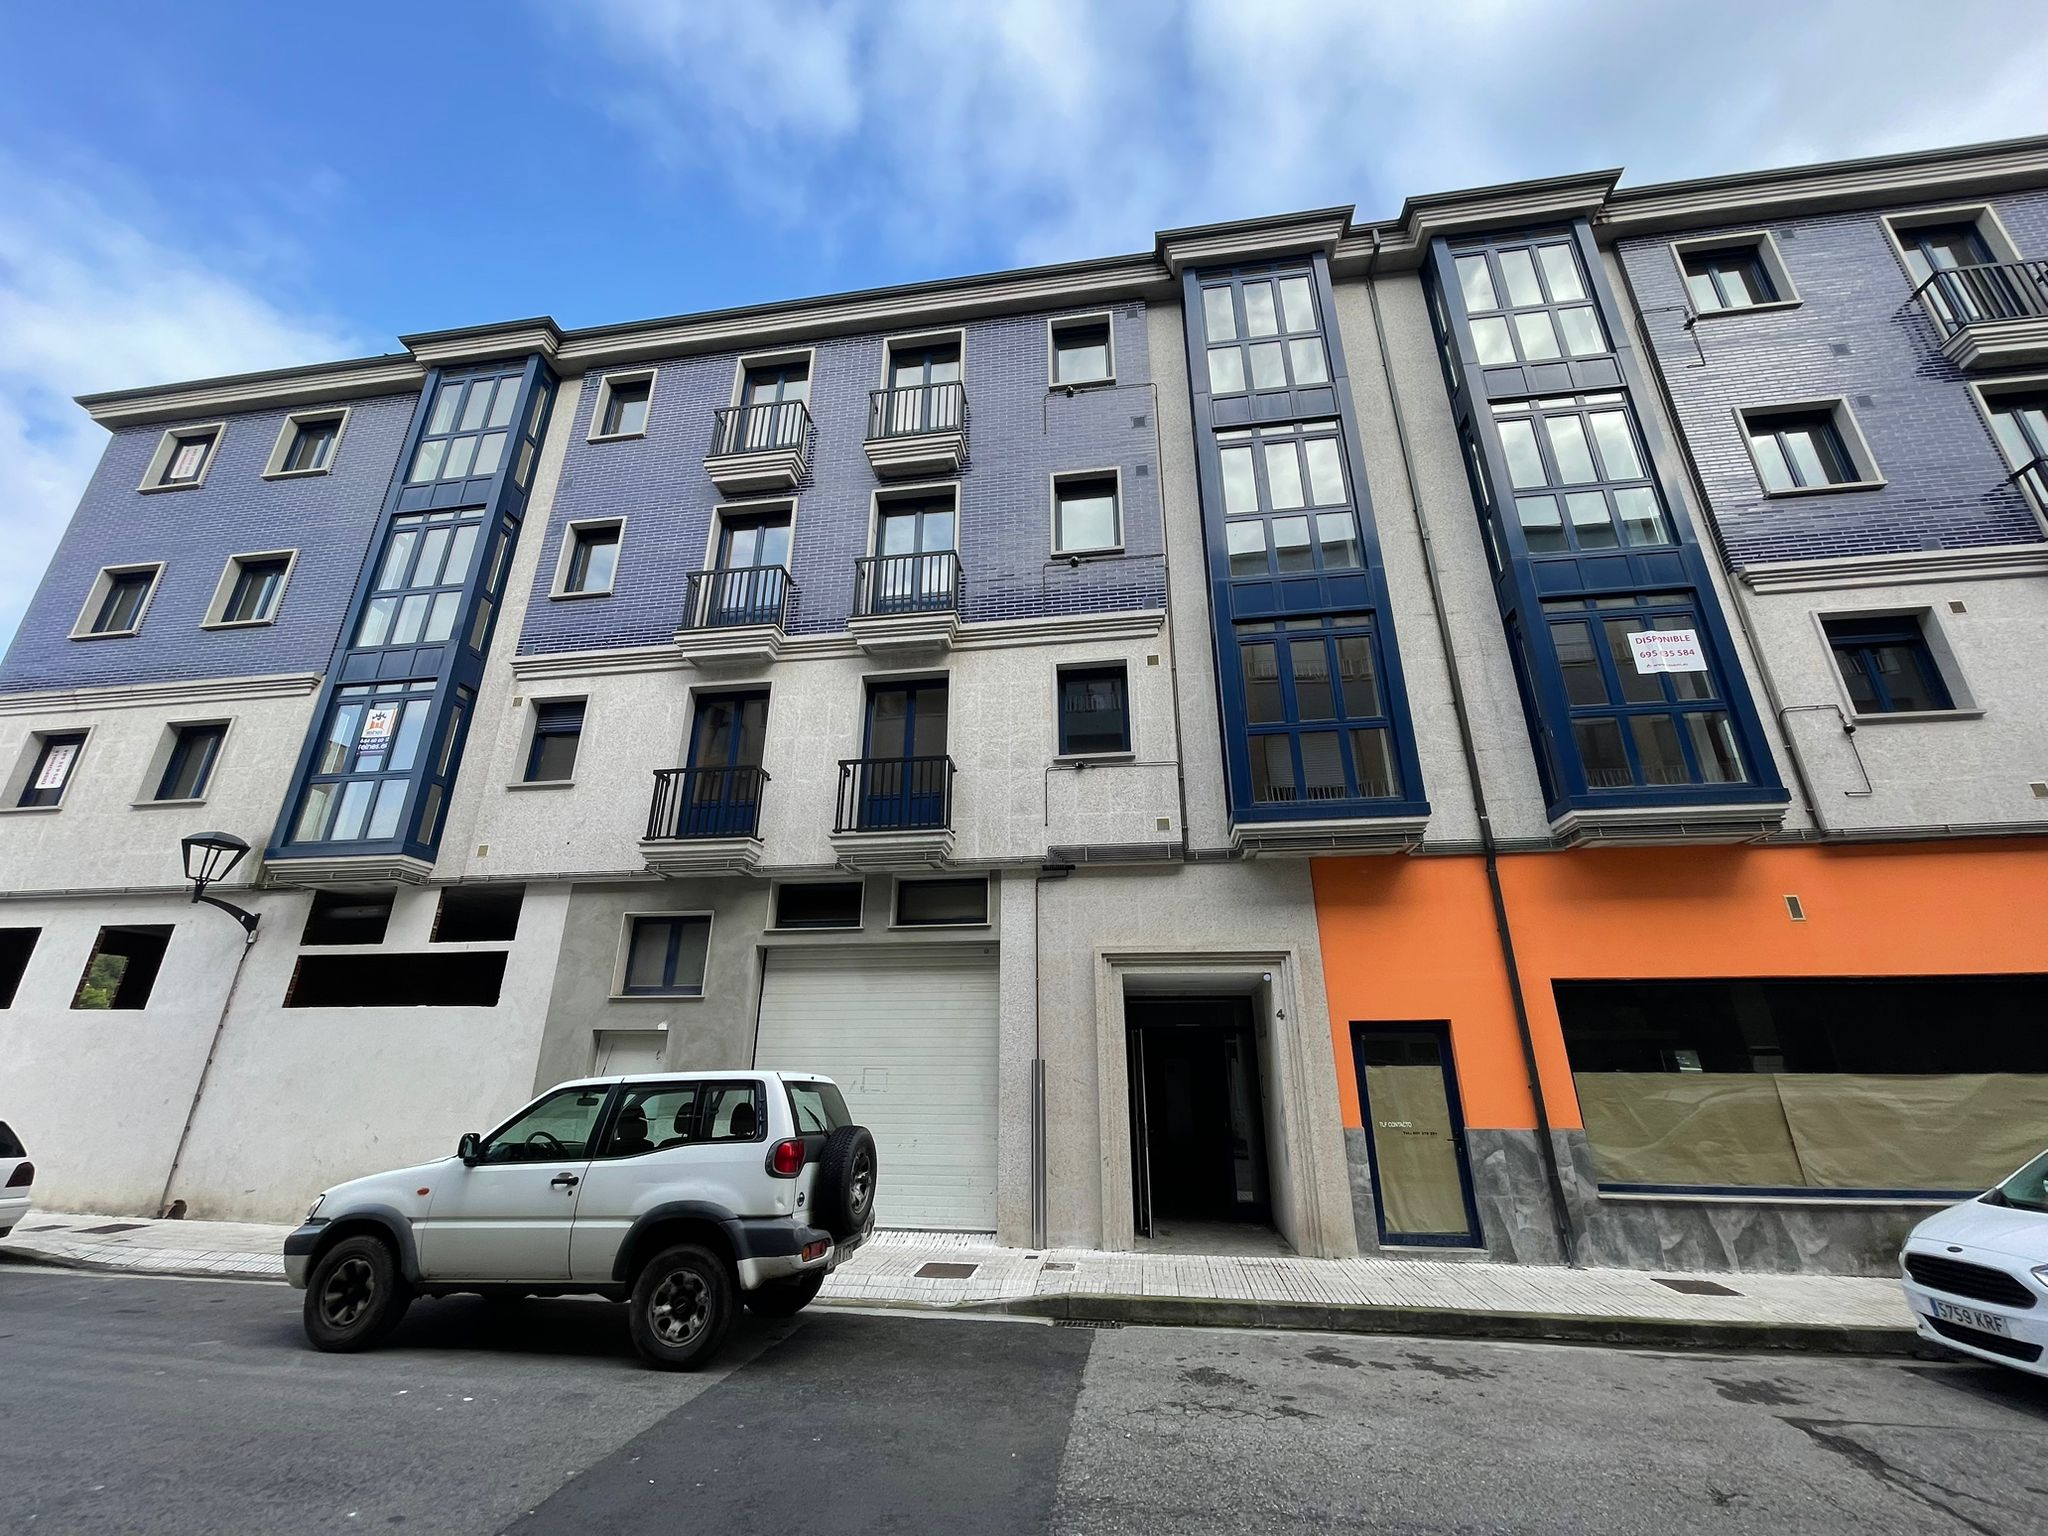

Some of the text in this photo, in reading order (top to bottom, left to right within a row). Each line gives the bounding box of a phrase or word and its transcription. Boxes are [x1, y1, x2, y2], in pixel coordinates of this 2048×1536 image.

[1635, 634, 1691, 645] DISPONIBLE
[1640, 650, 1658, 659] 695
[1677, 649, 1695, 658] 584
[1276, 1008, 1286, 1020] 4
[1938, 1302, 2003, 1333] 5759 KRF
